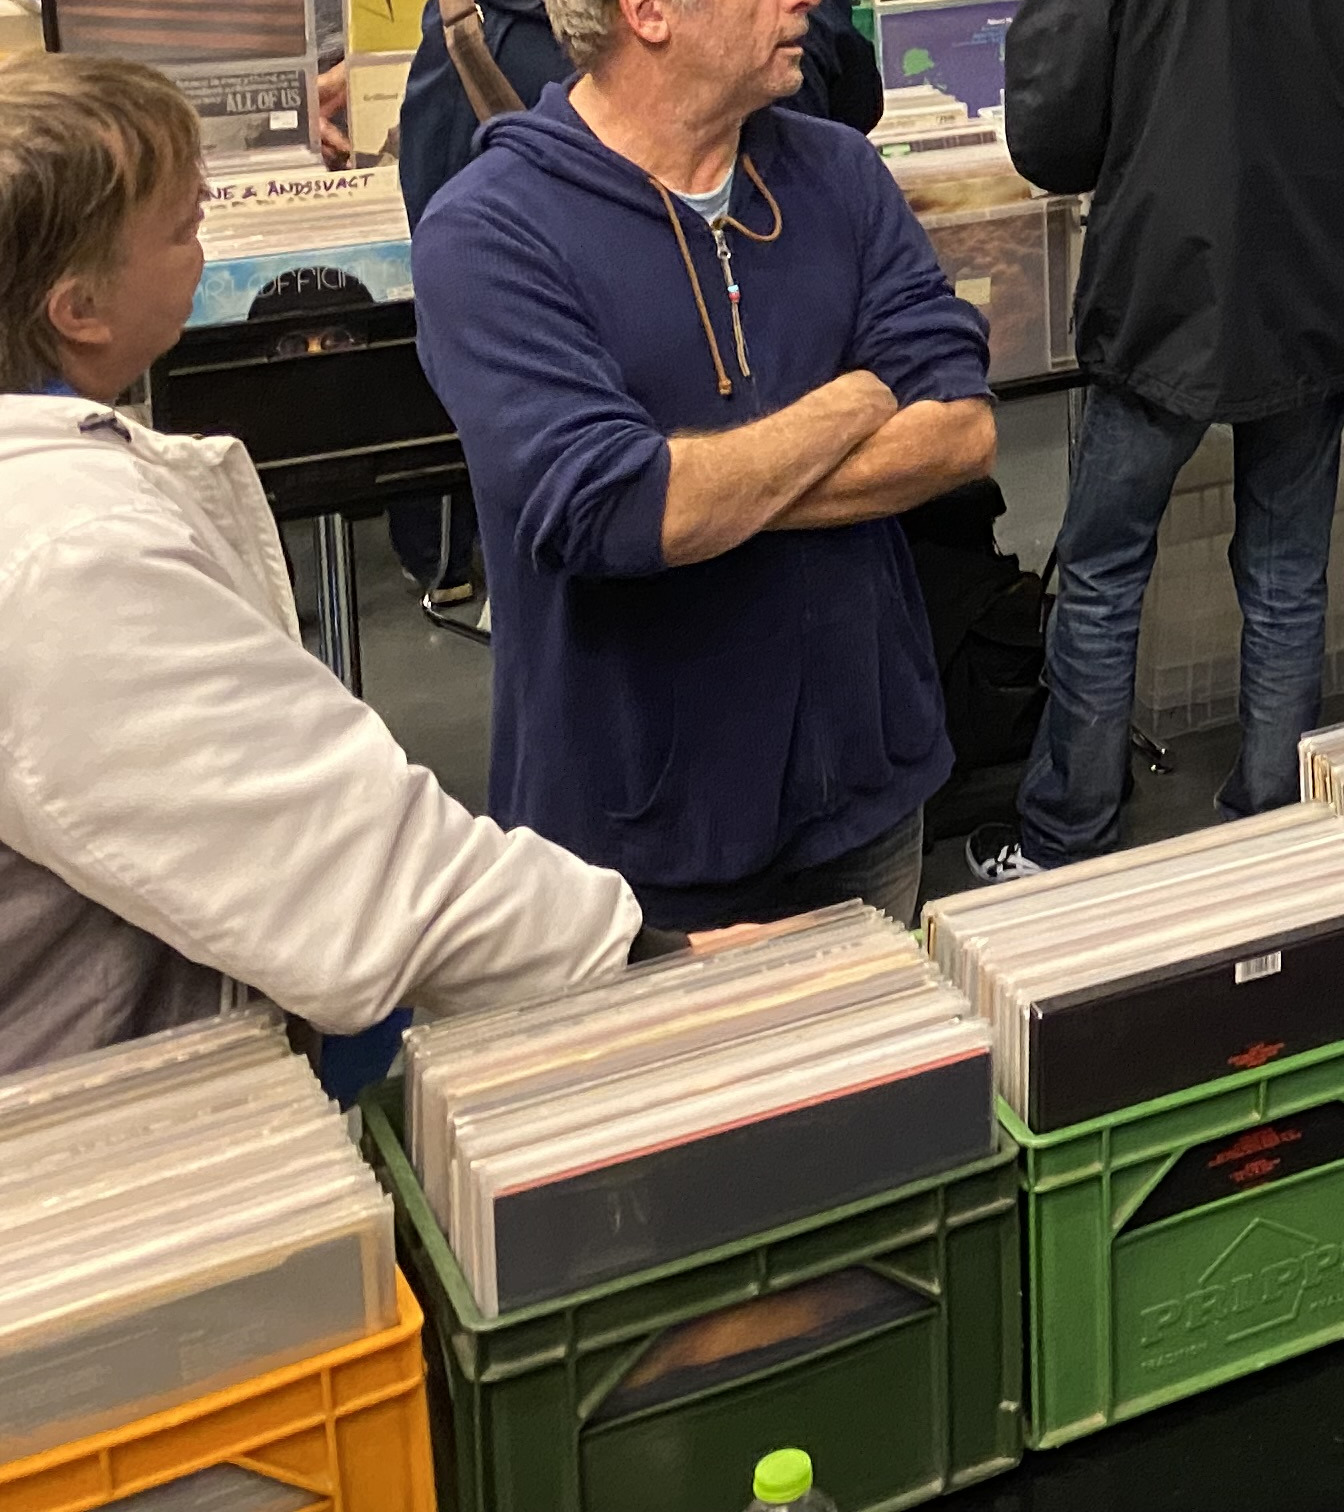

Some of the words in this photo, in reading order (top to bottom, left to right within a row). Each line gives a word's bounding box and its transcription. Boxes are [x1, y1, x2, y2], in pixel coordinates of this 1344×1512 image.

[226, 92, 257, 113] ALL
[258, 90, 278, 109] OF
[281, 88, 303, 108] US
